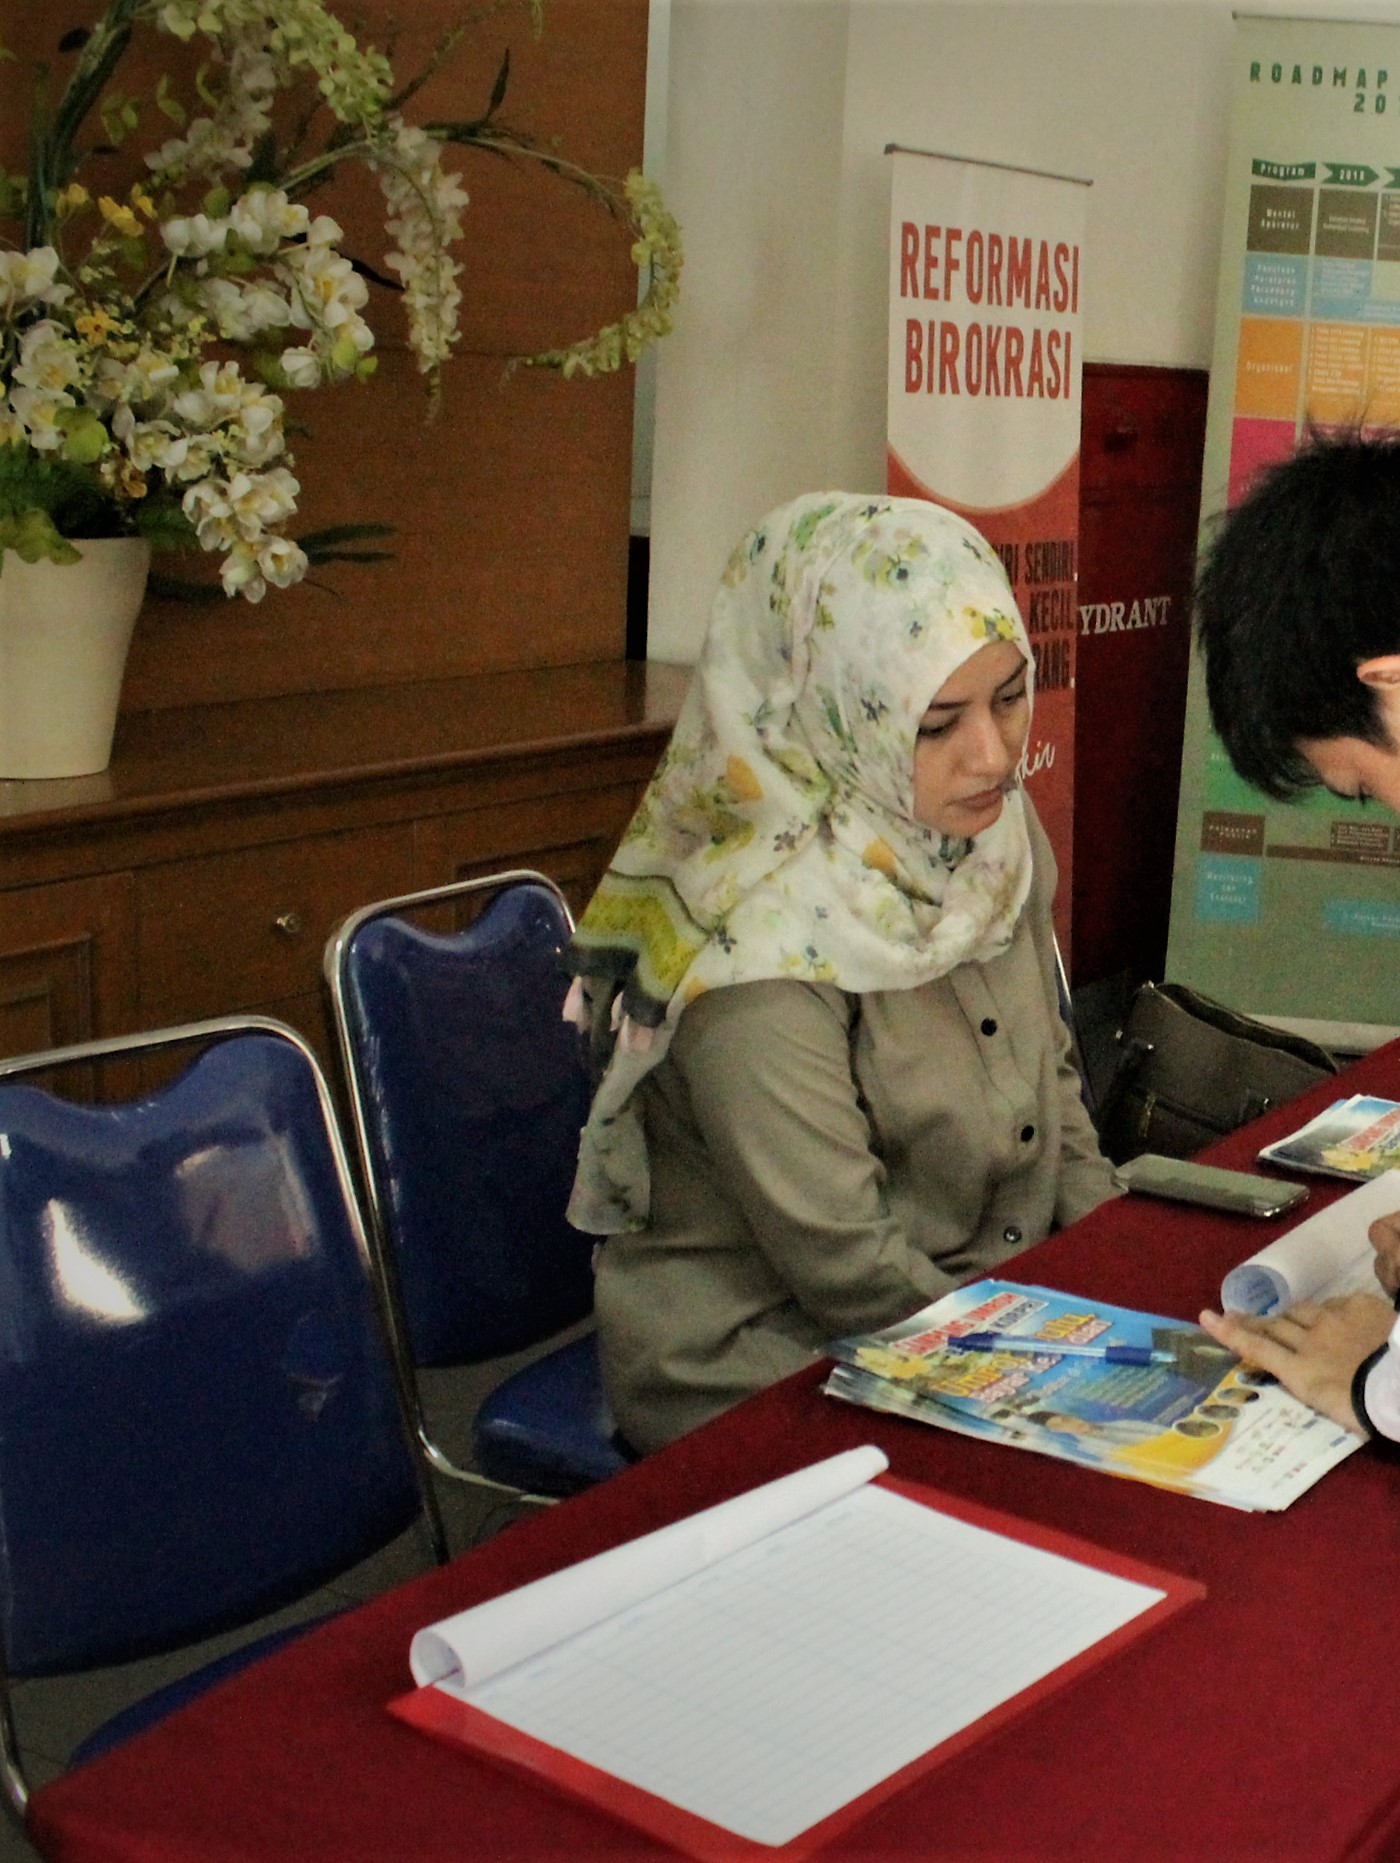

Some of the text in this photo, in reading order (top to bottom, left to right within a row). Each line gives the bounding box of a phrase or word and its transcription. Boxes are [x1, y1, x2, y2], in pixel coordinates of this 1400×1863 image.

[1250, 61, 1388, 89] ROADMAP
[1260, 163, 1305, 177] Program
[900, 221, 1080, 314] REFORMASI
[905, 318, 1072, 400] BIROKRASI
[1029, 588, 1075, 634] KECIL
[1078, 596, 1171, 636] YDRANT
